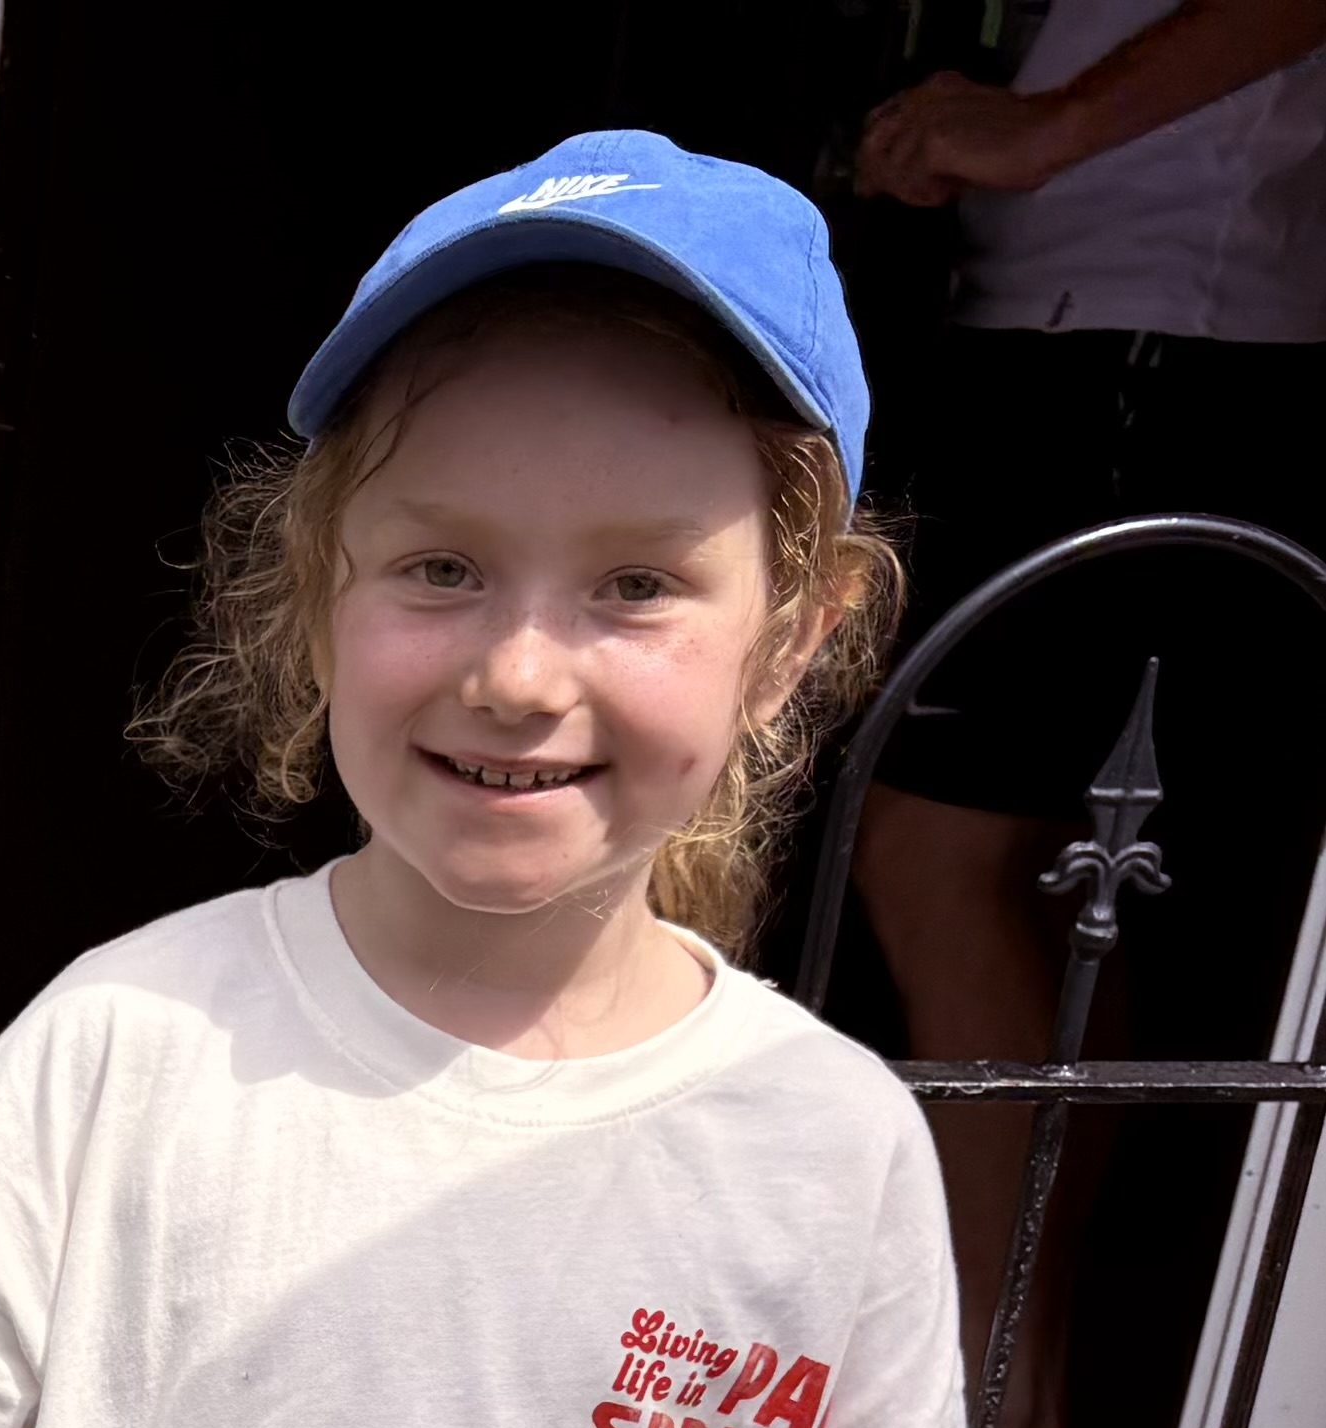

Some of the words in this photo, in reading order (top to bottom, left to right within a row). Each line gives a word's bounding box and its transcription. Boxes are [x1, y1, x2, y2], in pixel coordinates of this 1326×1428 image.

[526, 174, 629, 202] NIKE
[621, 1308, 738, 1379] Living
[612, 1352, 672, 1402] life
[676, 1371, 707, 1408] in
